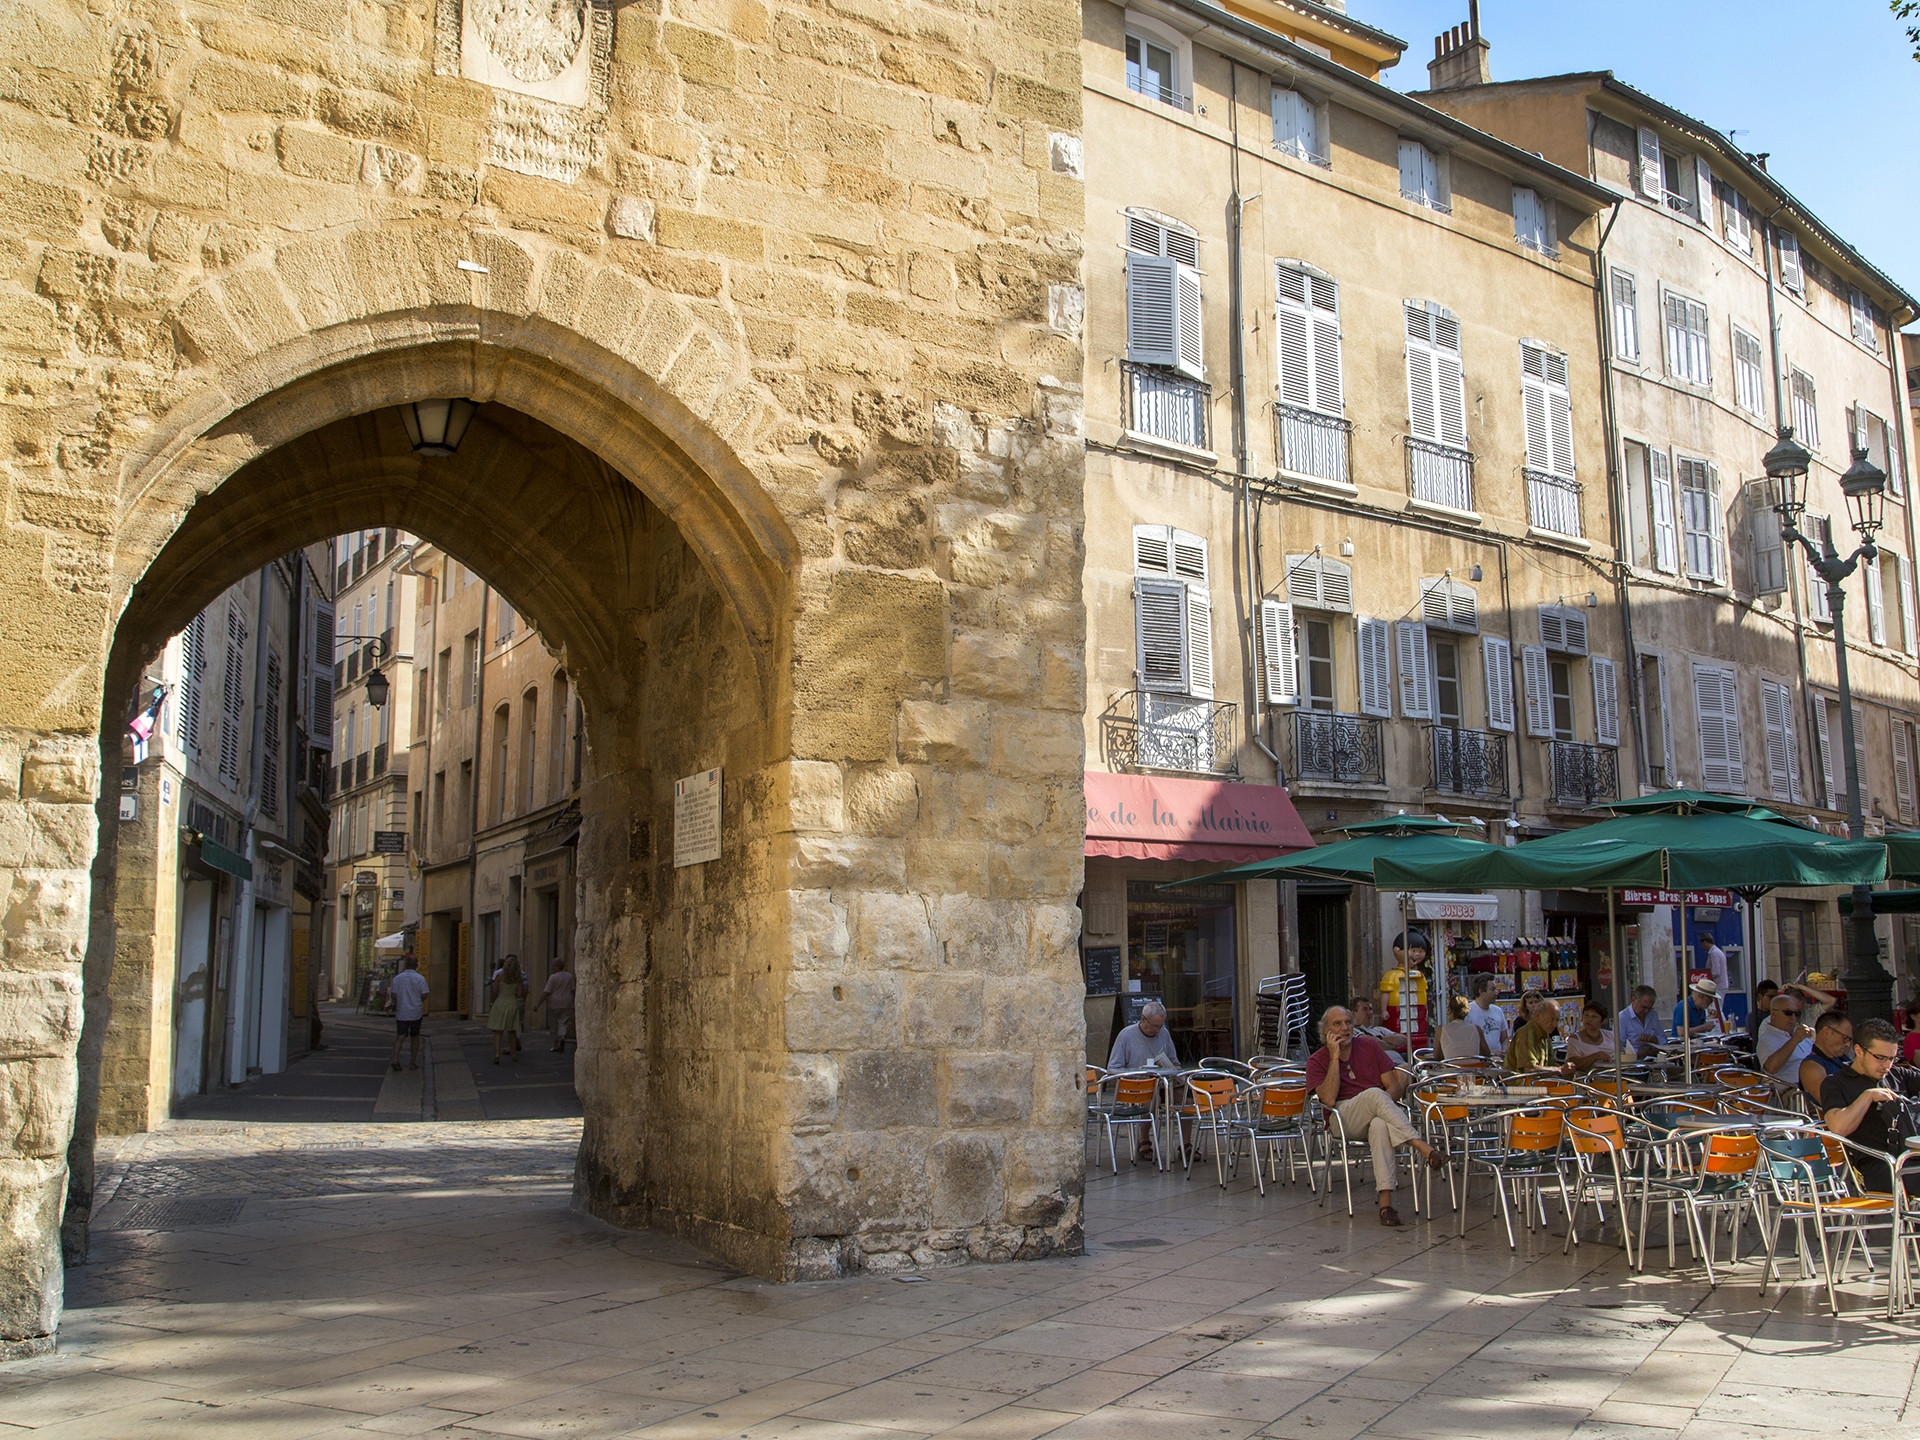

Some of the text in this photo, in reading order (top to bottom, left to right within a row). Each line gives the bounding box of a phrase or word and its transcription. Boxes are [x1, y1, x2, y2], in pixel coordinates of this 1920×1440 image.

[1110, 802, 1138, 826] de
[1152, 799, 1178, 827] la
[1188, 804, 1271, 833] Mairie
[1624, 890, 1727, 905] Bières Brasrie Tapas
